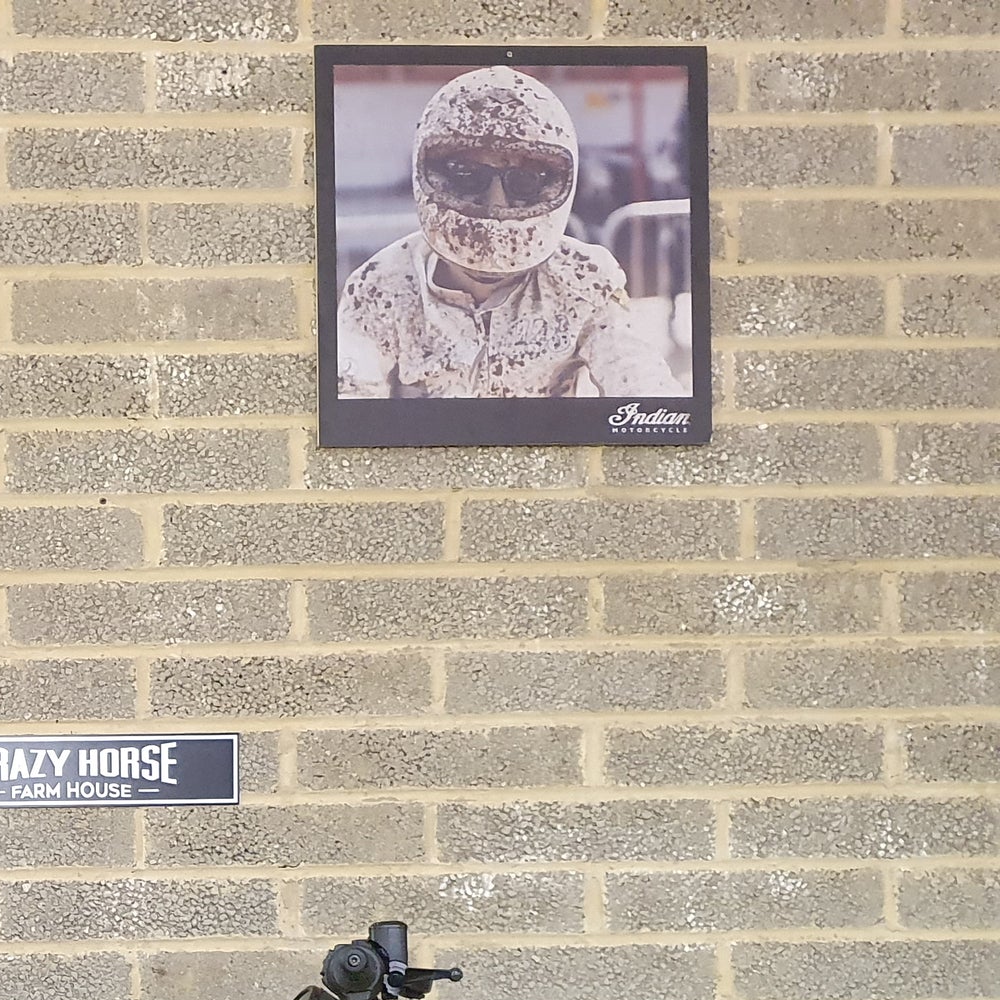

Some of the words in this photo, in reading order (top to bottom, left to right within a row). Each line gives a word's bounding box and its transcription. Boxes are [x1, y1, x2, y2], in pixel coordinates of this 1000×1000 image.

[608, 402, 691, 426] Indian
[78, 741, 178, 786] HORSE
[10, 784, 61, 799] FARM
[66, 781, 132, 798] HOUSE
